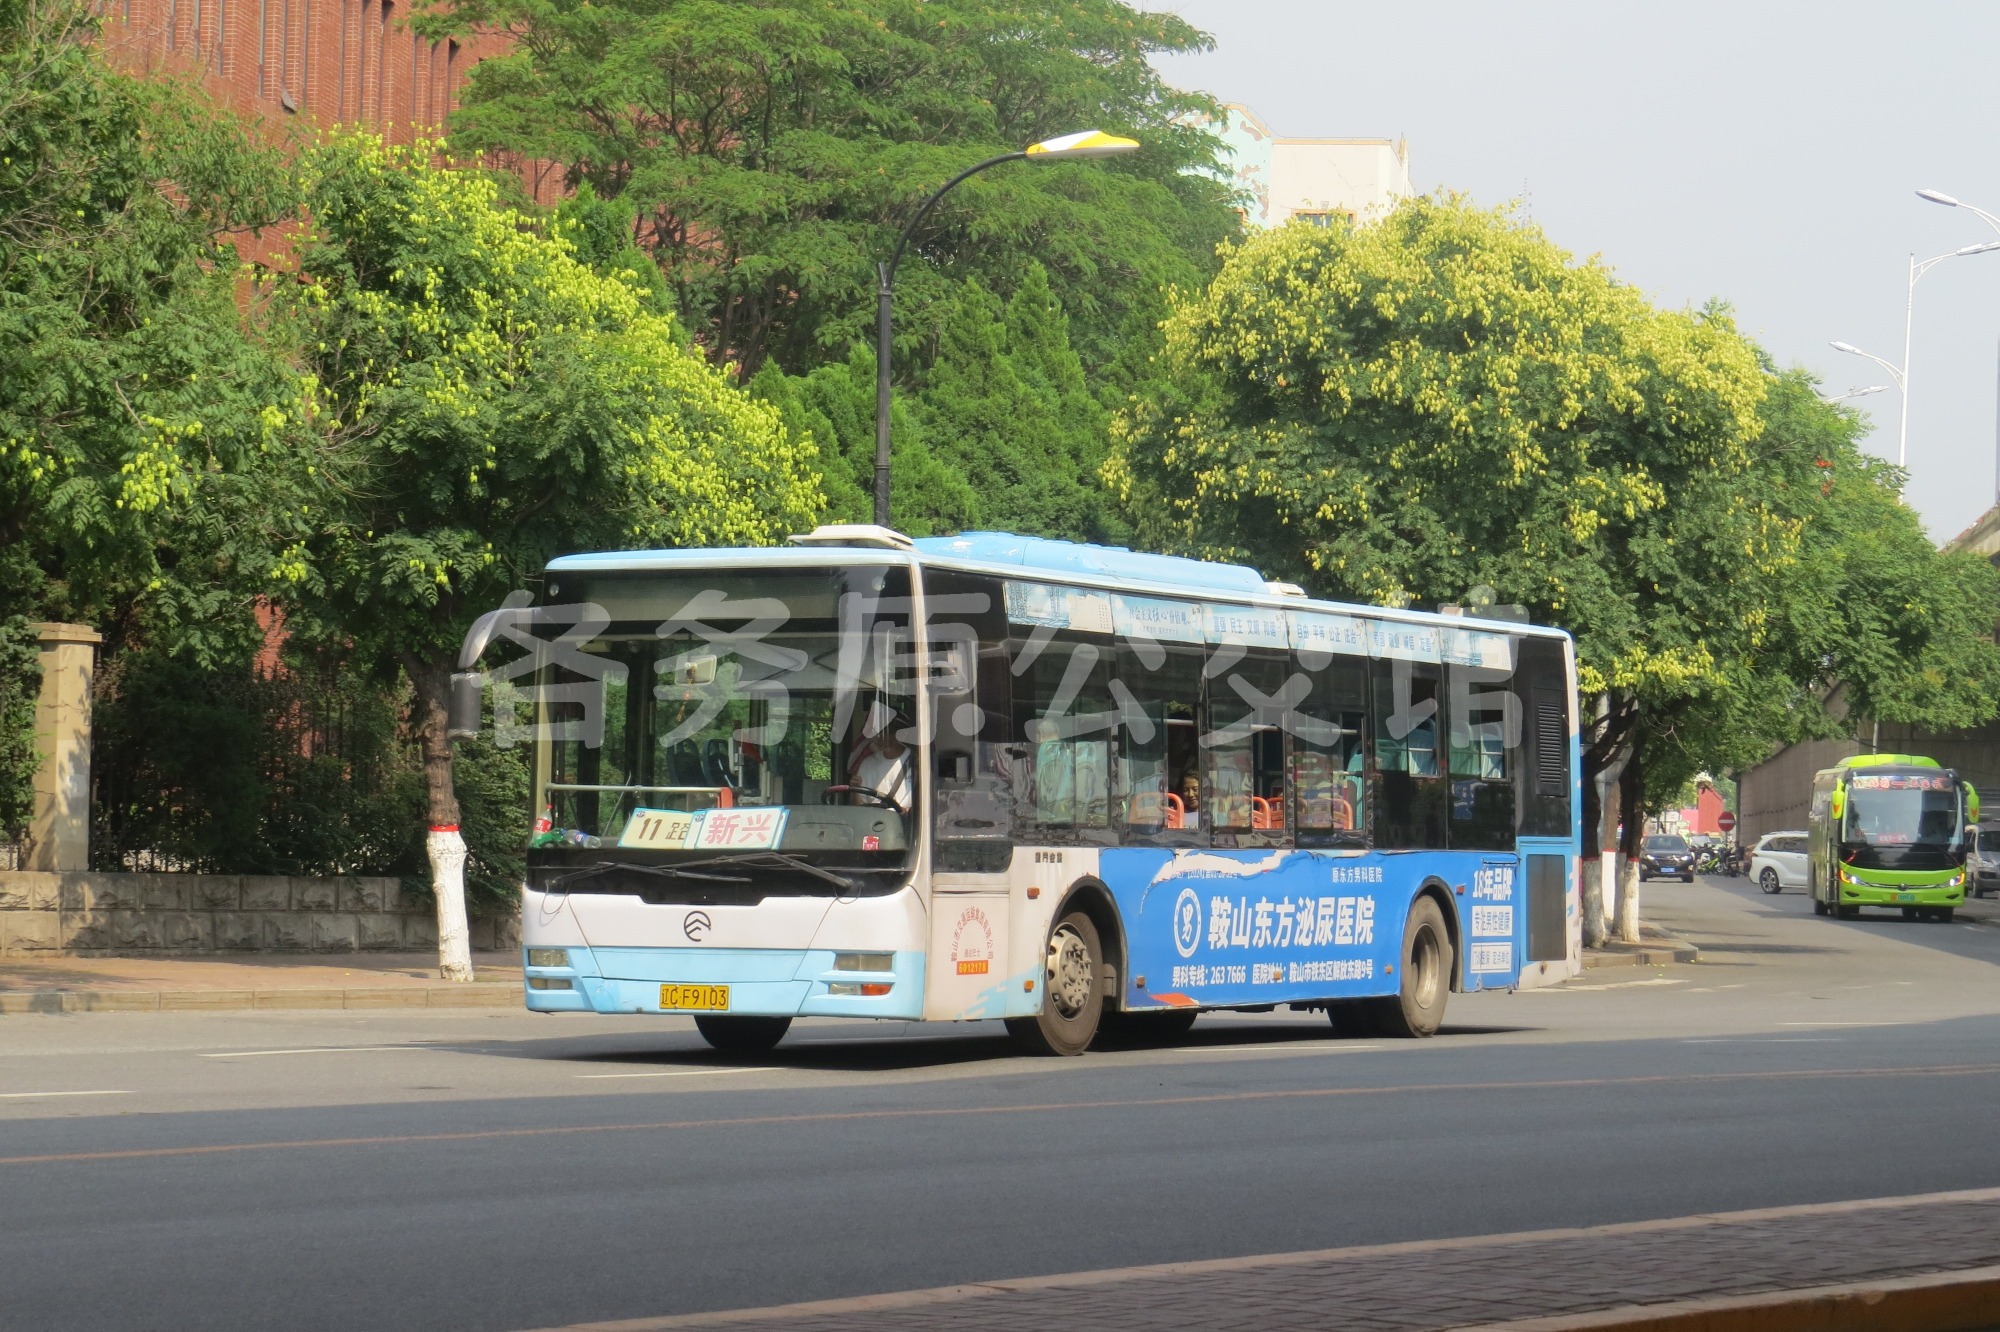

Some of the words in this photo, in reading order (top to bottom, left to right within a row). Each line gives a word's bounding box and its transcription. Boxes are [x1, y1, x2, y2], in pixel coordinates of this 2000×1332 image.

[1230, 617, 1243, 634] 民主
[1296, 624, 1309, 639] 自由
[1328, 626, 1341, 642] 公正
[704, 813, 772, 845] 新兴
[1332, 866, 1383, 884] 原东方男科医院
[1472, 867, 1513, 901] 18年品牌
[1208, 895, 1376, 950] 鞍山东方泌尿医院
